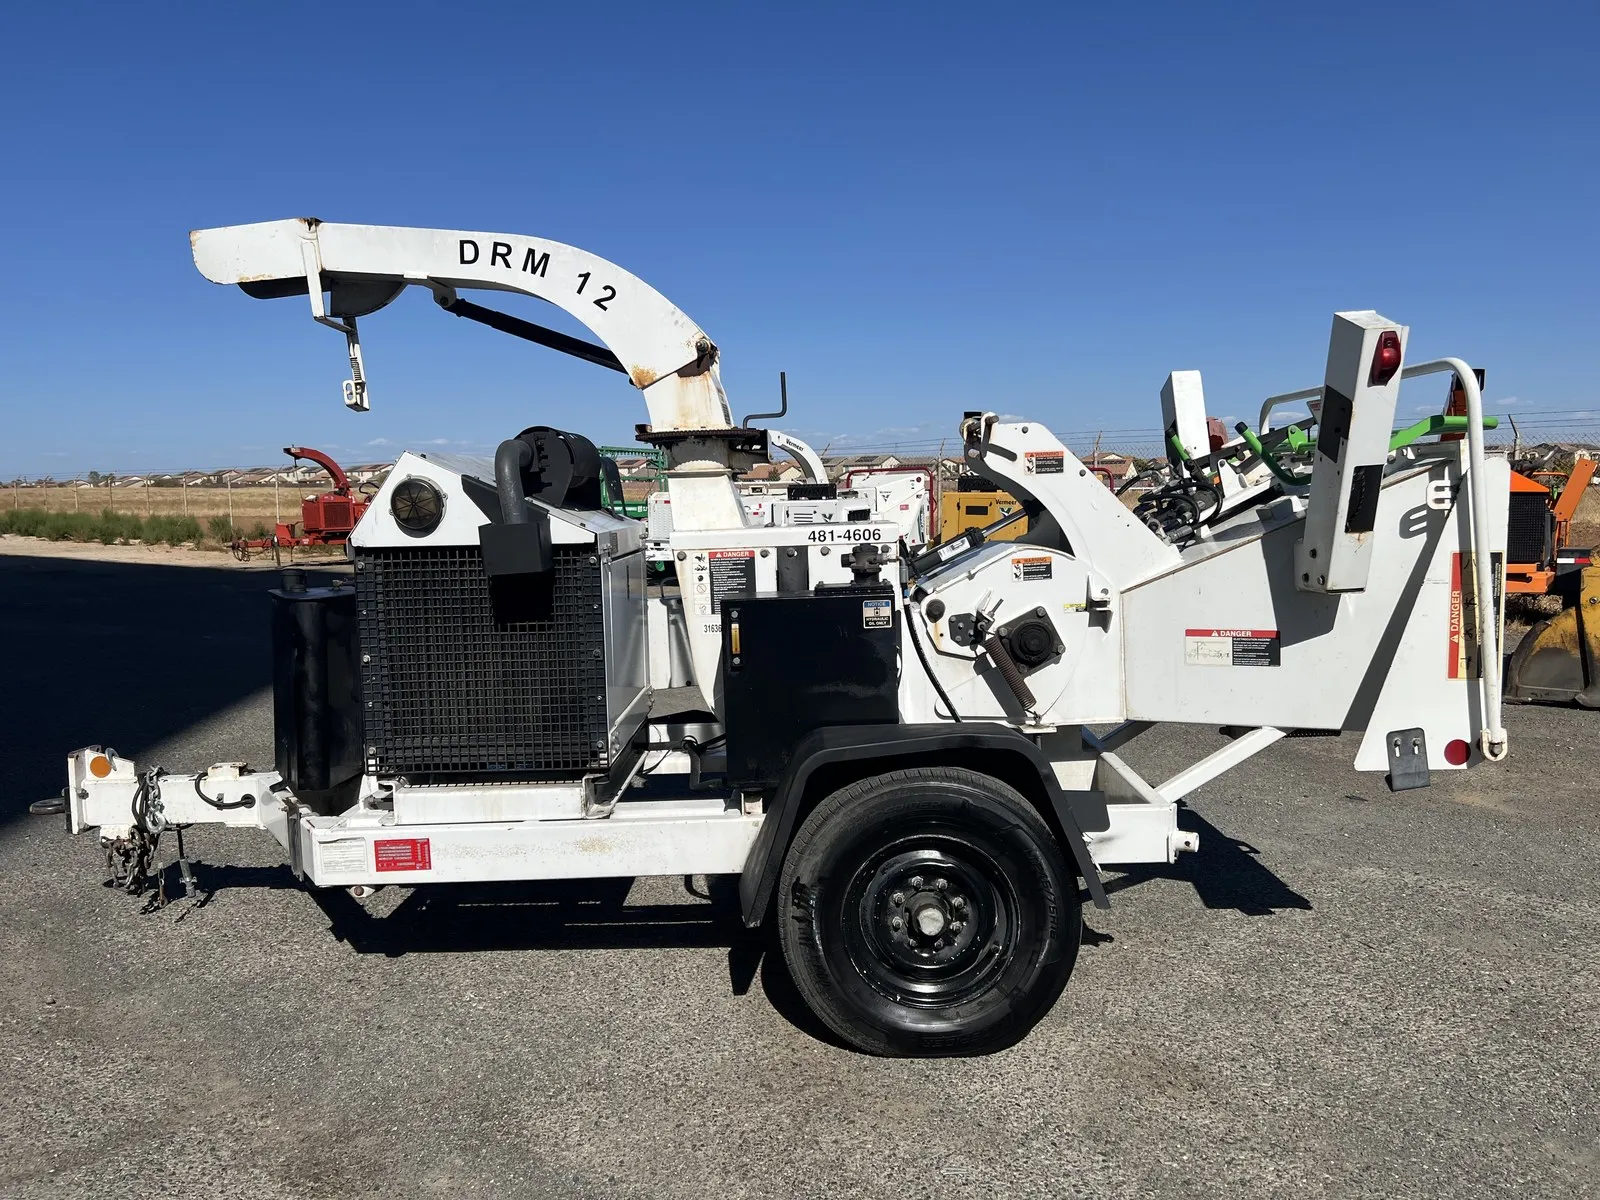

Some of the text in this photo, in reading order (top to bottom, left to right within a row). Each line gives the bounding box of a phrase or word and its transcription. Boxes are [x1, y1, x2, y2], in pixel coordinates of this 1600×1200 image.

[459, 240, 617, 312] DRM 12
[808, 528, 881, 542] 481-4606
[1451, 590, 1460, 631] DANGER
